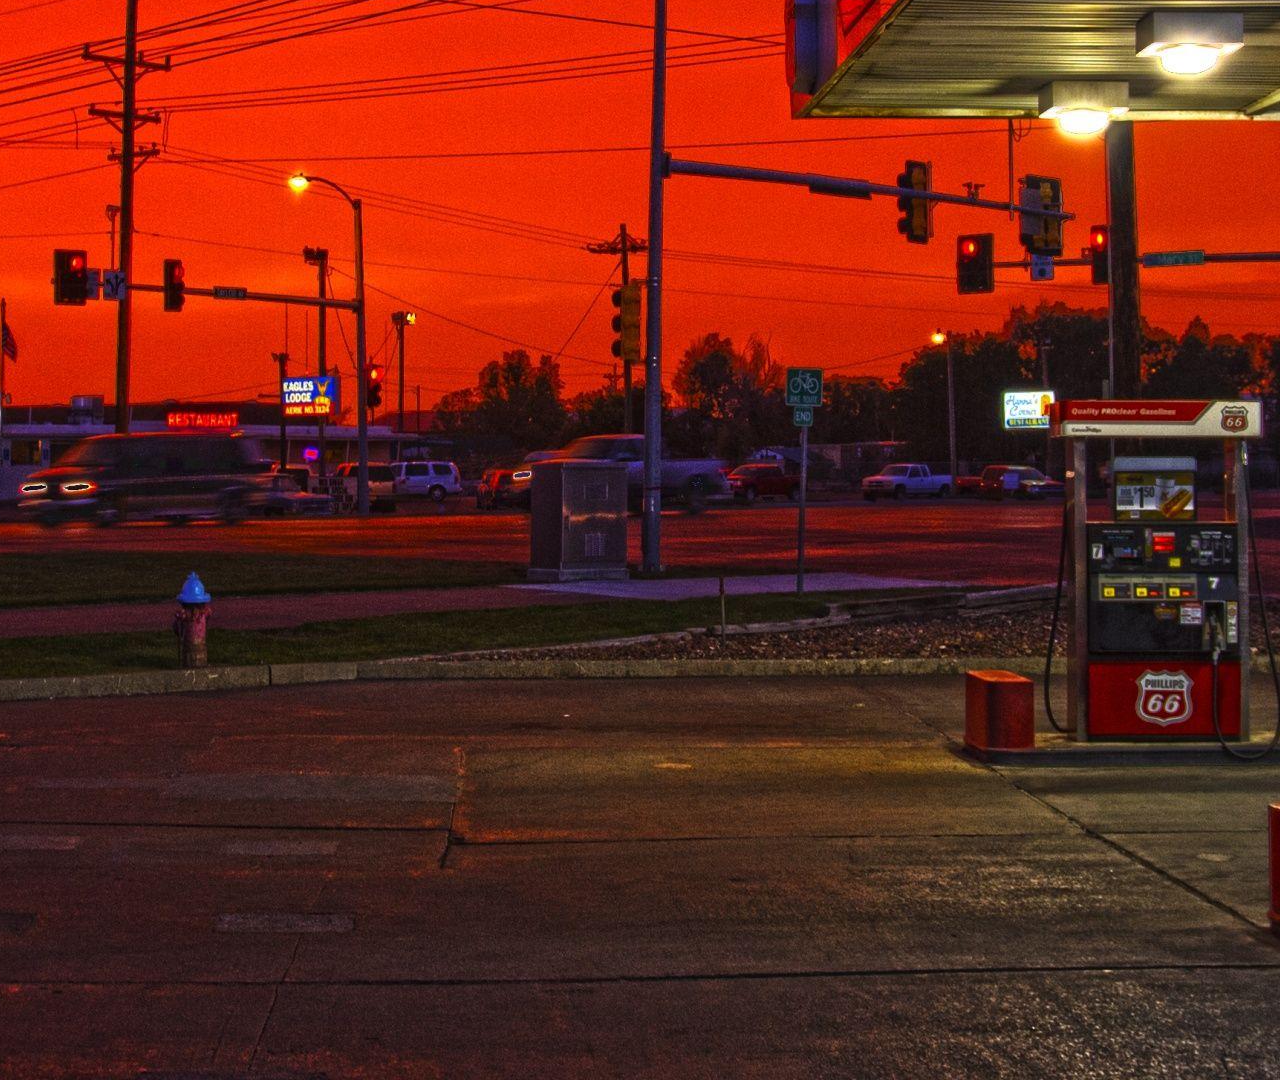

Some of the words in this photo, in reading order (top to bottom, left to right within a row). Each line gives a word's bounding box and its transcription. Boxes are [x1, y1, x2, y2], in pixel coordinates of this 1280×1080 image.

[283, 381, 314, 392] EAGLES
[285, 392, 312, 403] LODGE
[795, 411, 811, 422] END
[1071, 408, 1100, 416] Quality
[168, 413, 239, 427] RESTAURANT
[1226, 417, 1242, 427] 66
[1208, 577, 1219, 589] 7
[1144, 678, 1186, 689] PHILLIPS
[1148, 694, 1181, 712] 66
